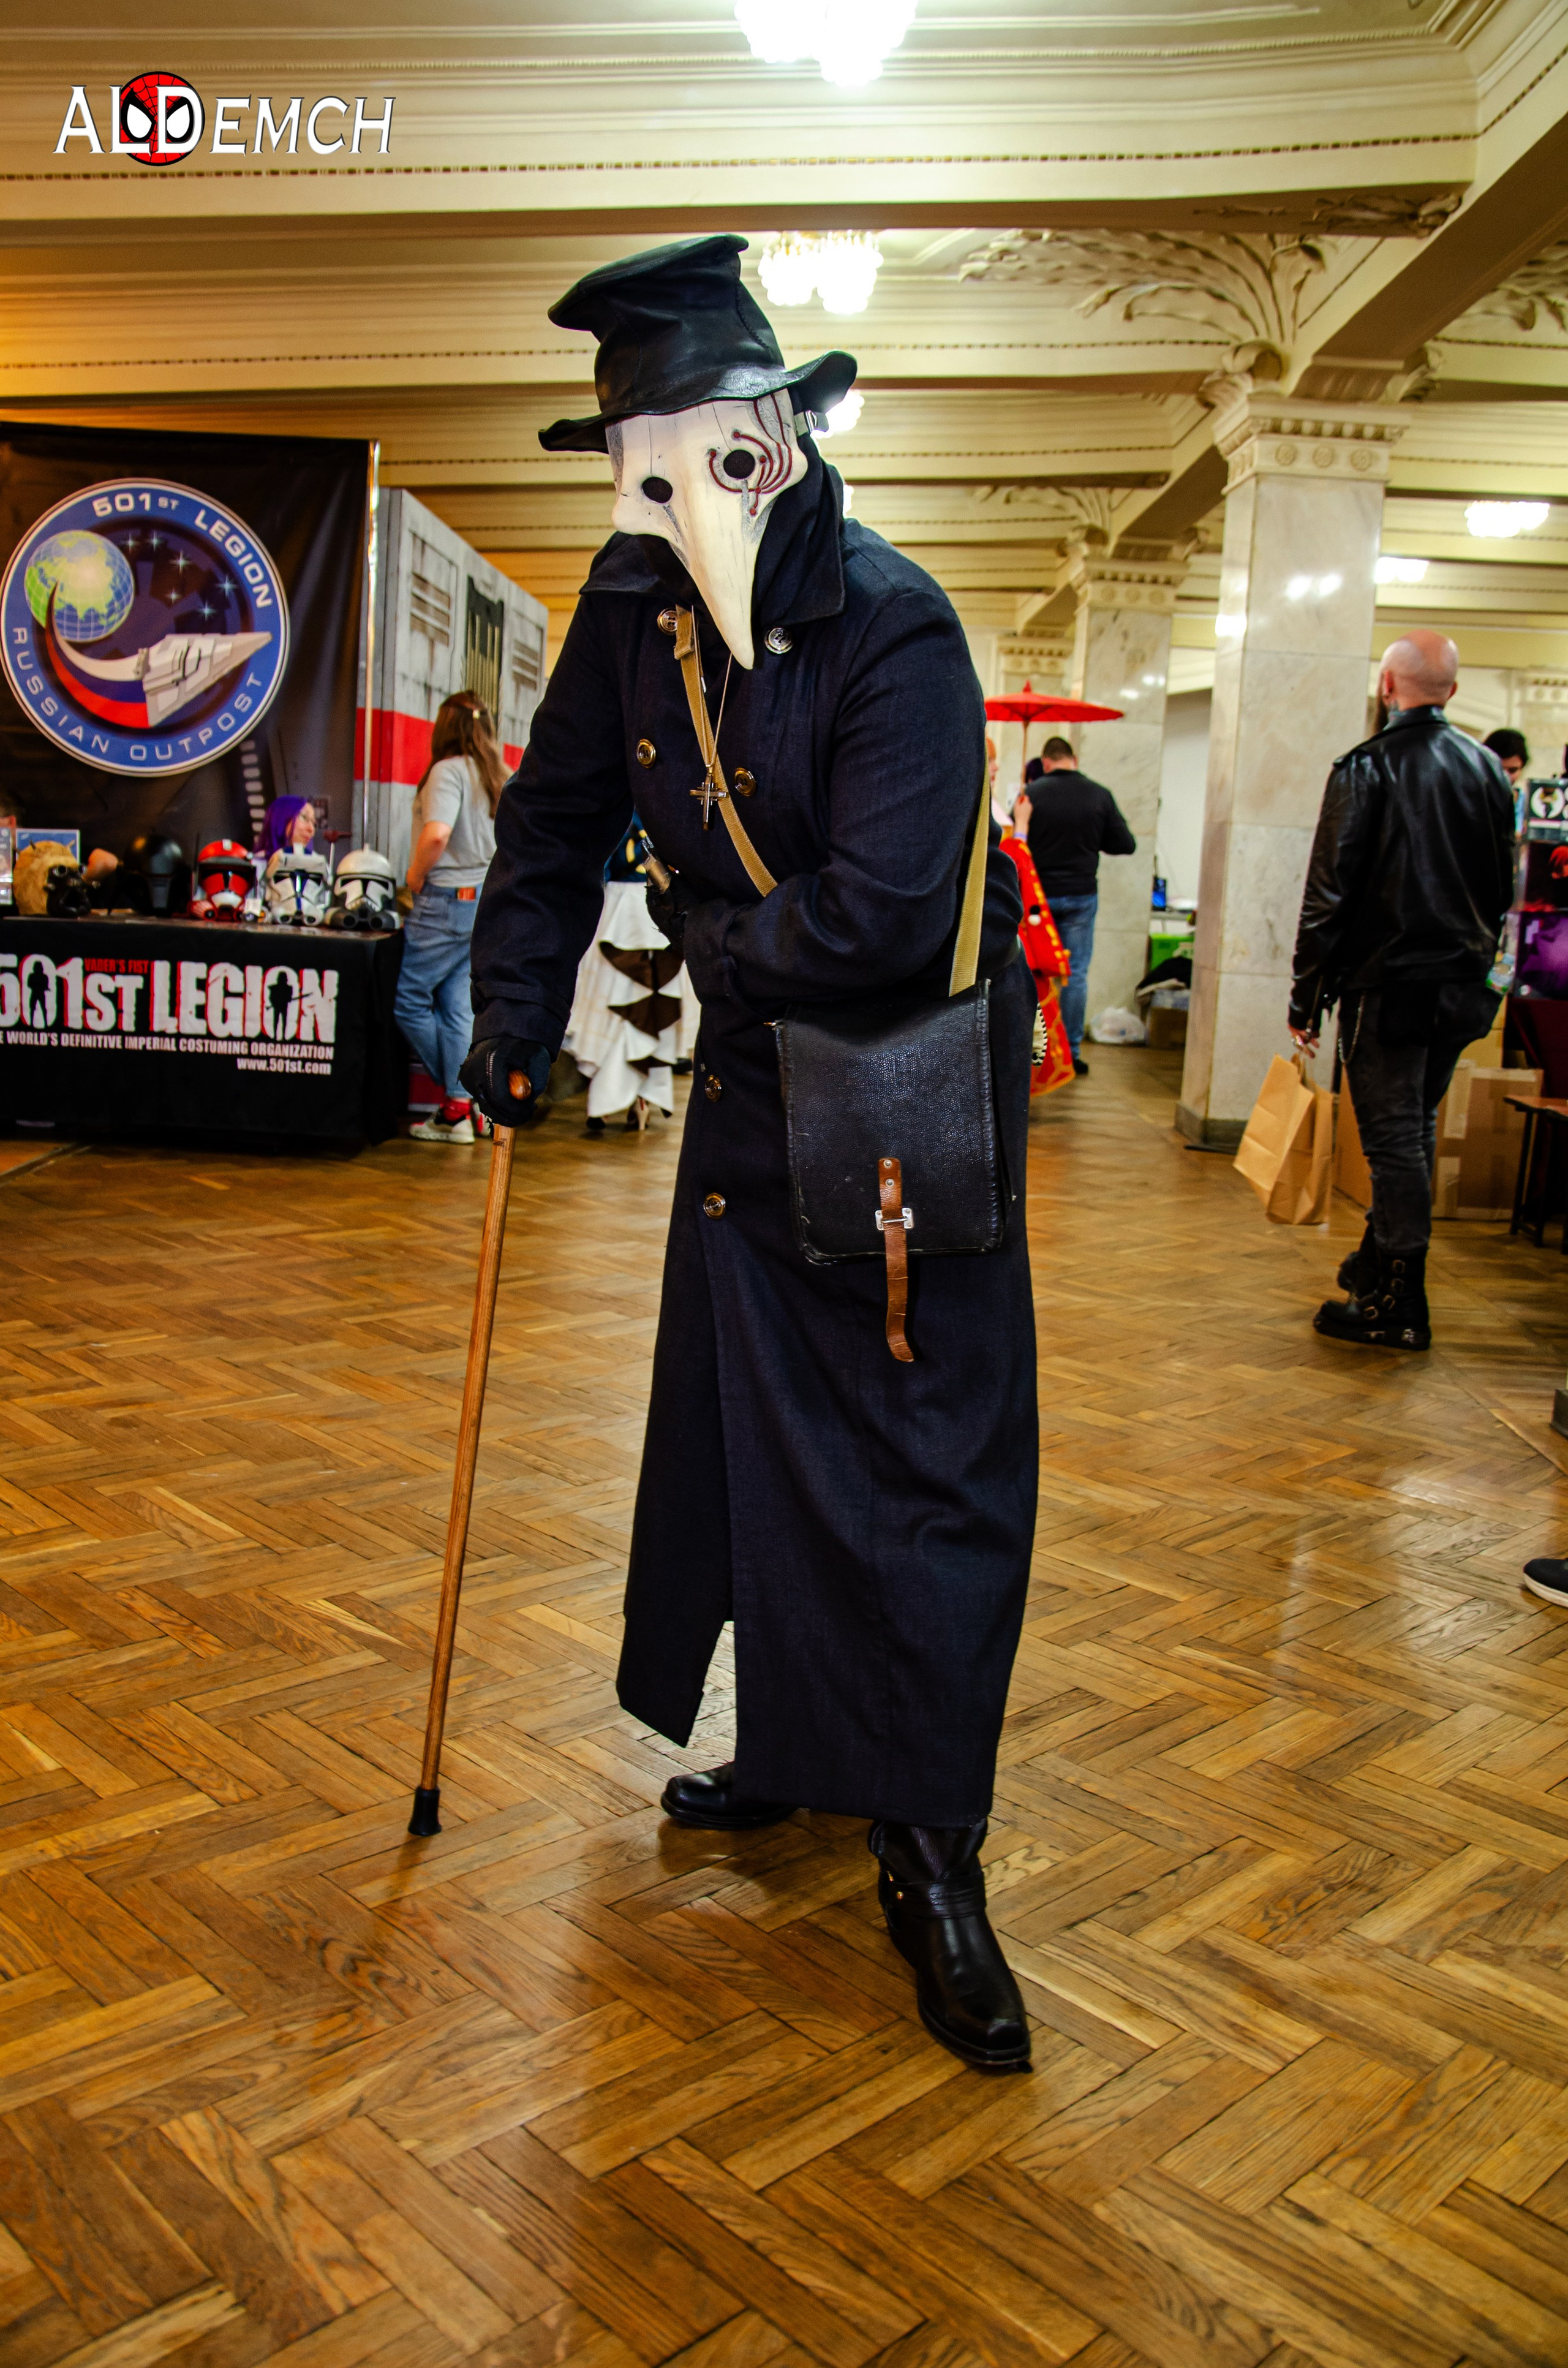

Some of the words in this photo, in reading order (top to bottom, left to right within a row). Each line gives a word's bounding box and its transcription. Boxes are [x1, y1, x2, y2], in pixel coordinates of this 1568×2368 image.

[194, 509, 274, 608] LEGION
[13, 627, 110, 754] RUSSIAN
[130, 673, 262, 761] OUTPOST
[84, 958, 126, 973] VADER'S
[128, 959, 149, 974] FIST
[149, 960, 339, 1043] LEGION
[7, 1031, 59, 1046] WORLD'S
[61, 1032, 123, 1049] DEFINITIVE
[124, 1035, 176, 1052] IMPERIAL
[179, 1038, 249, 1055] COSTUMING
[251, 1043, 334, 1061] ORGANIZATION
[236, 1057, 332, 1076] www.501st.com
